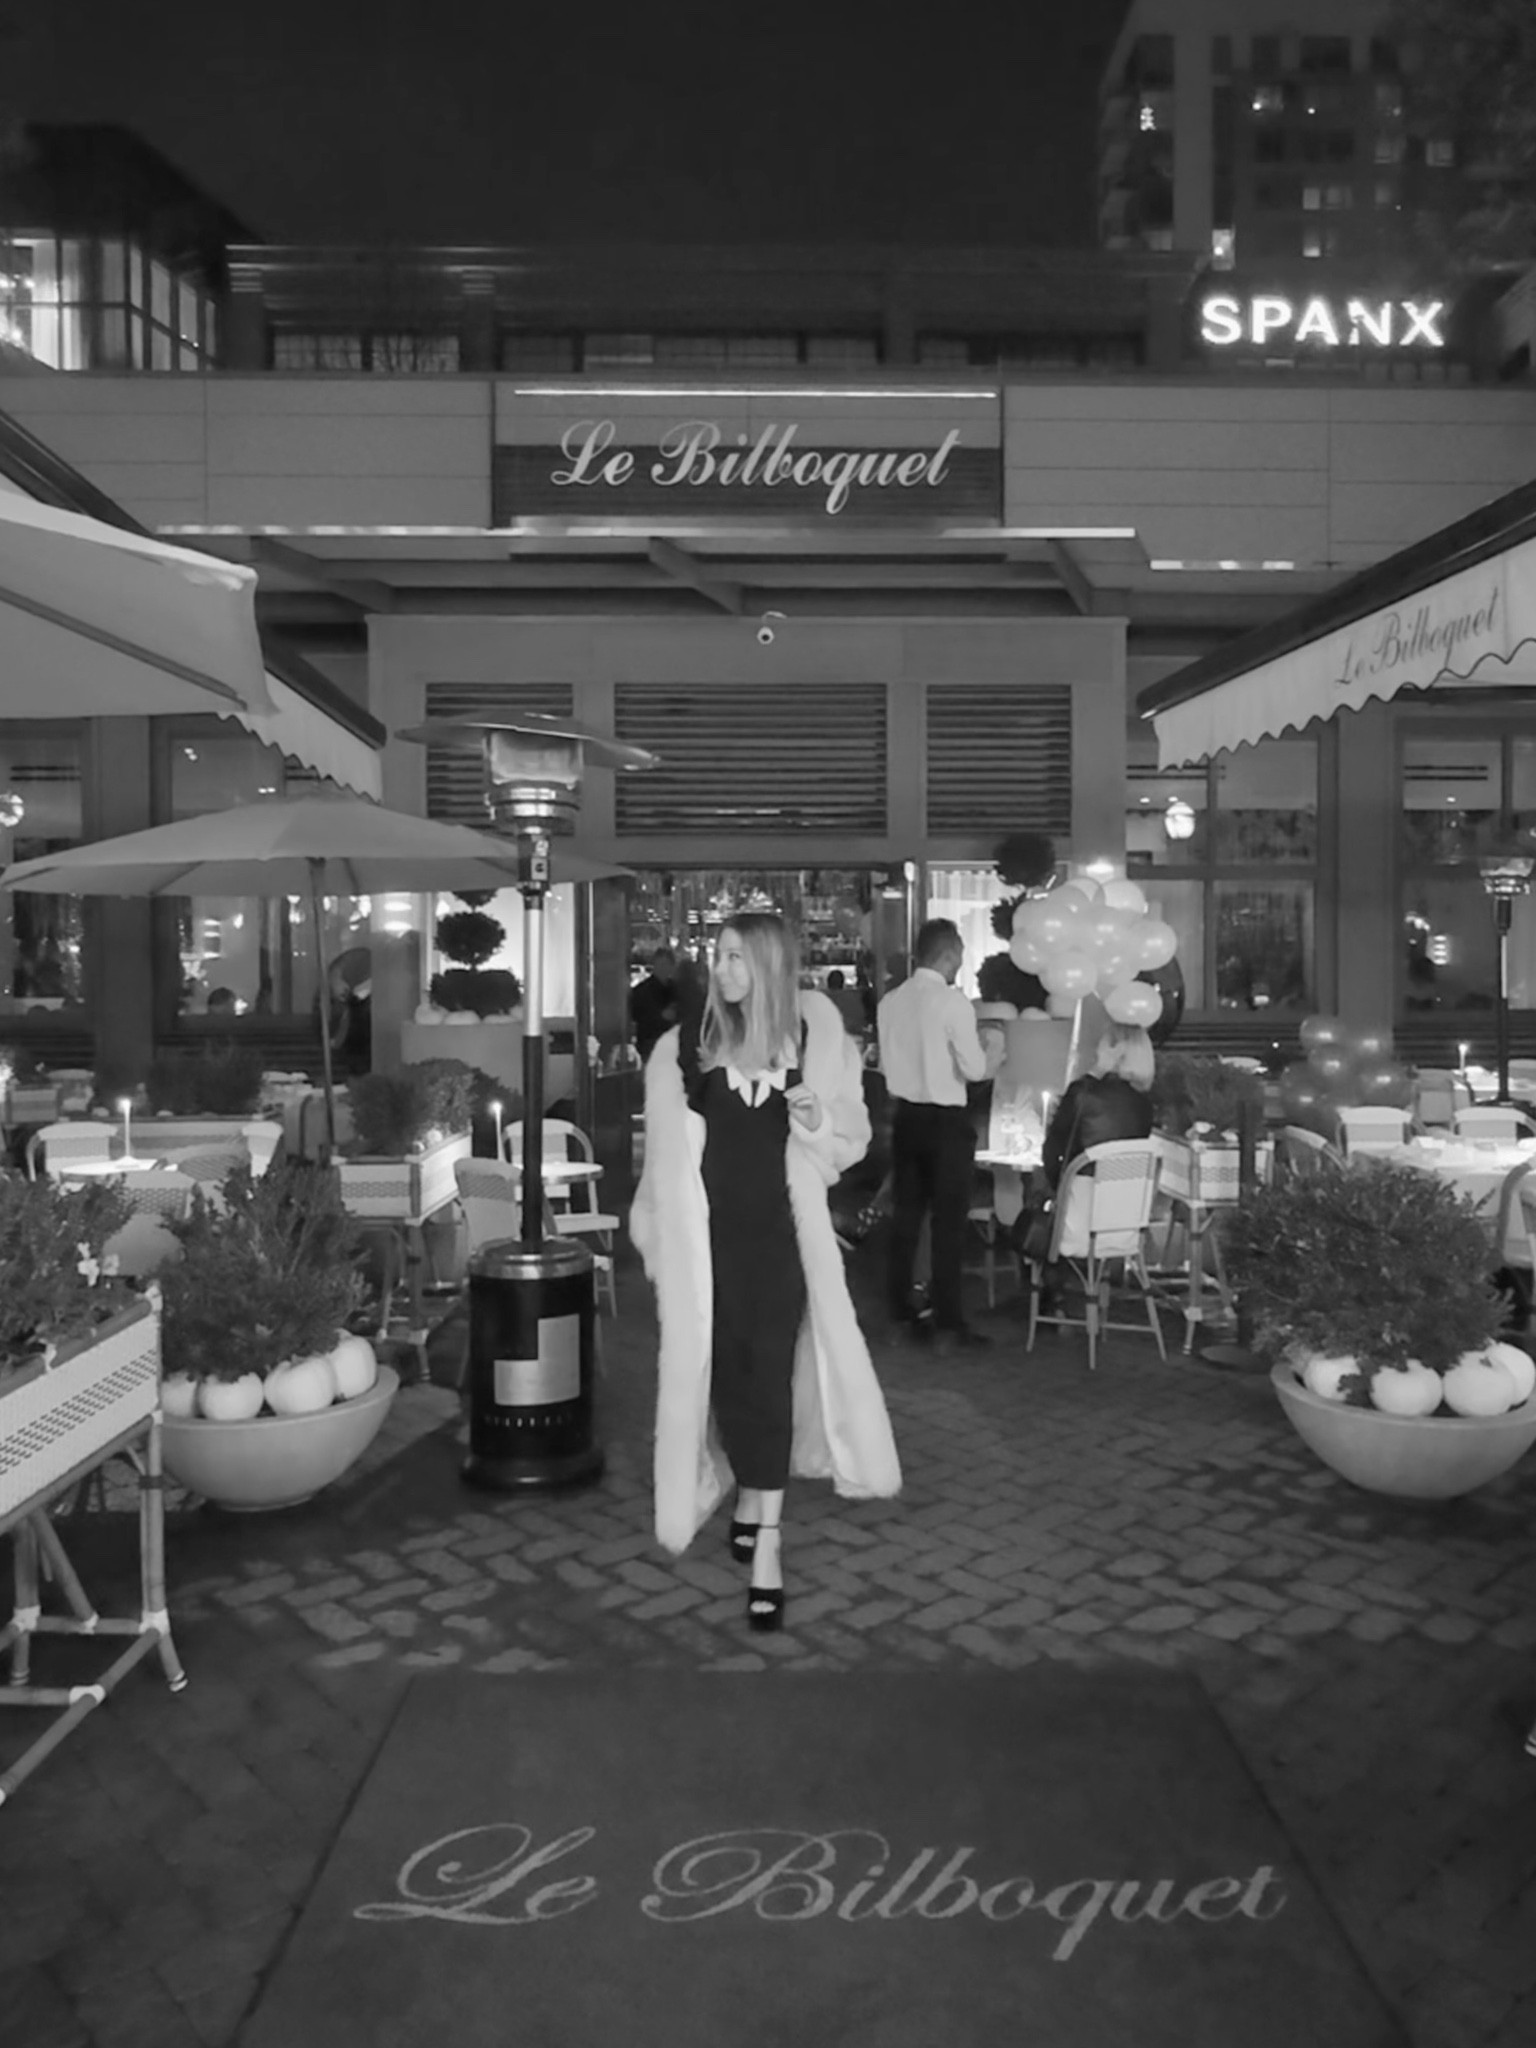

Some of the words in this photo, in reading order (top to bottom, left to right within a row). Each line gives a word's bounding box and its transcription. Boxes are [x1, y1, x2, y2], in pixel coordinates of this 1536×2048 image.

[1201, 298, 1444, 346] SPANX
[550, 420, 634, 486] Le
[651, 420, 962, 514] Bilboquet
[1369, 586, 1498, 673] Bilboquet
[353, 1822, 598, 1925] Le
[640, 1827, 1288, 1961] Bilboquet
